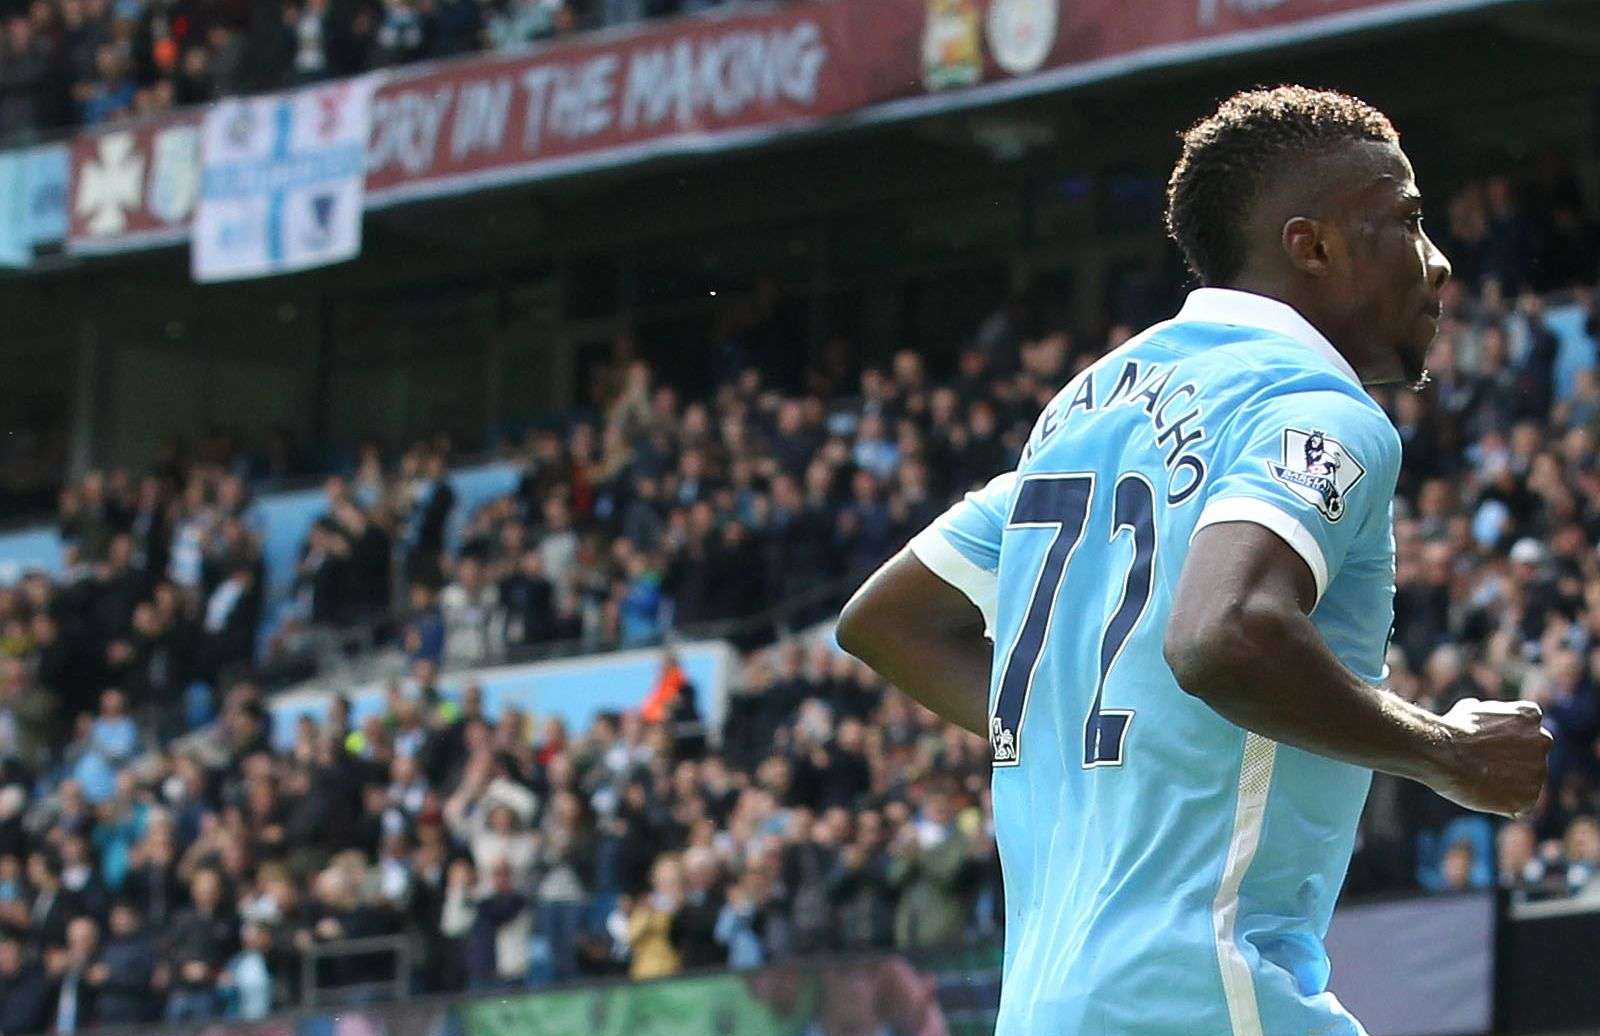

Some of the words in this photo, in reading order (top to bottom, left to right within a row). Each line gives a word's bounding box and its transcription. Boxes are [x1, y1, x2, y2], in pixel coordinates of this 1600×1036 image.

[450, 80, 513, 163] IN
[520, 54, 620, 153] THE
[617, 22, 828, 132] MAKING
[990, 472, 1156, 768] 72
